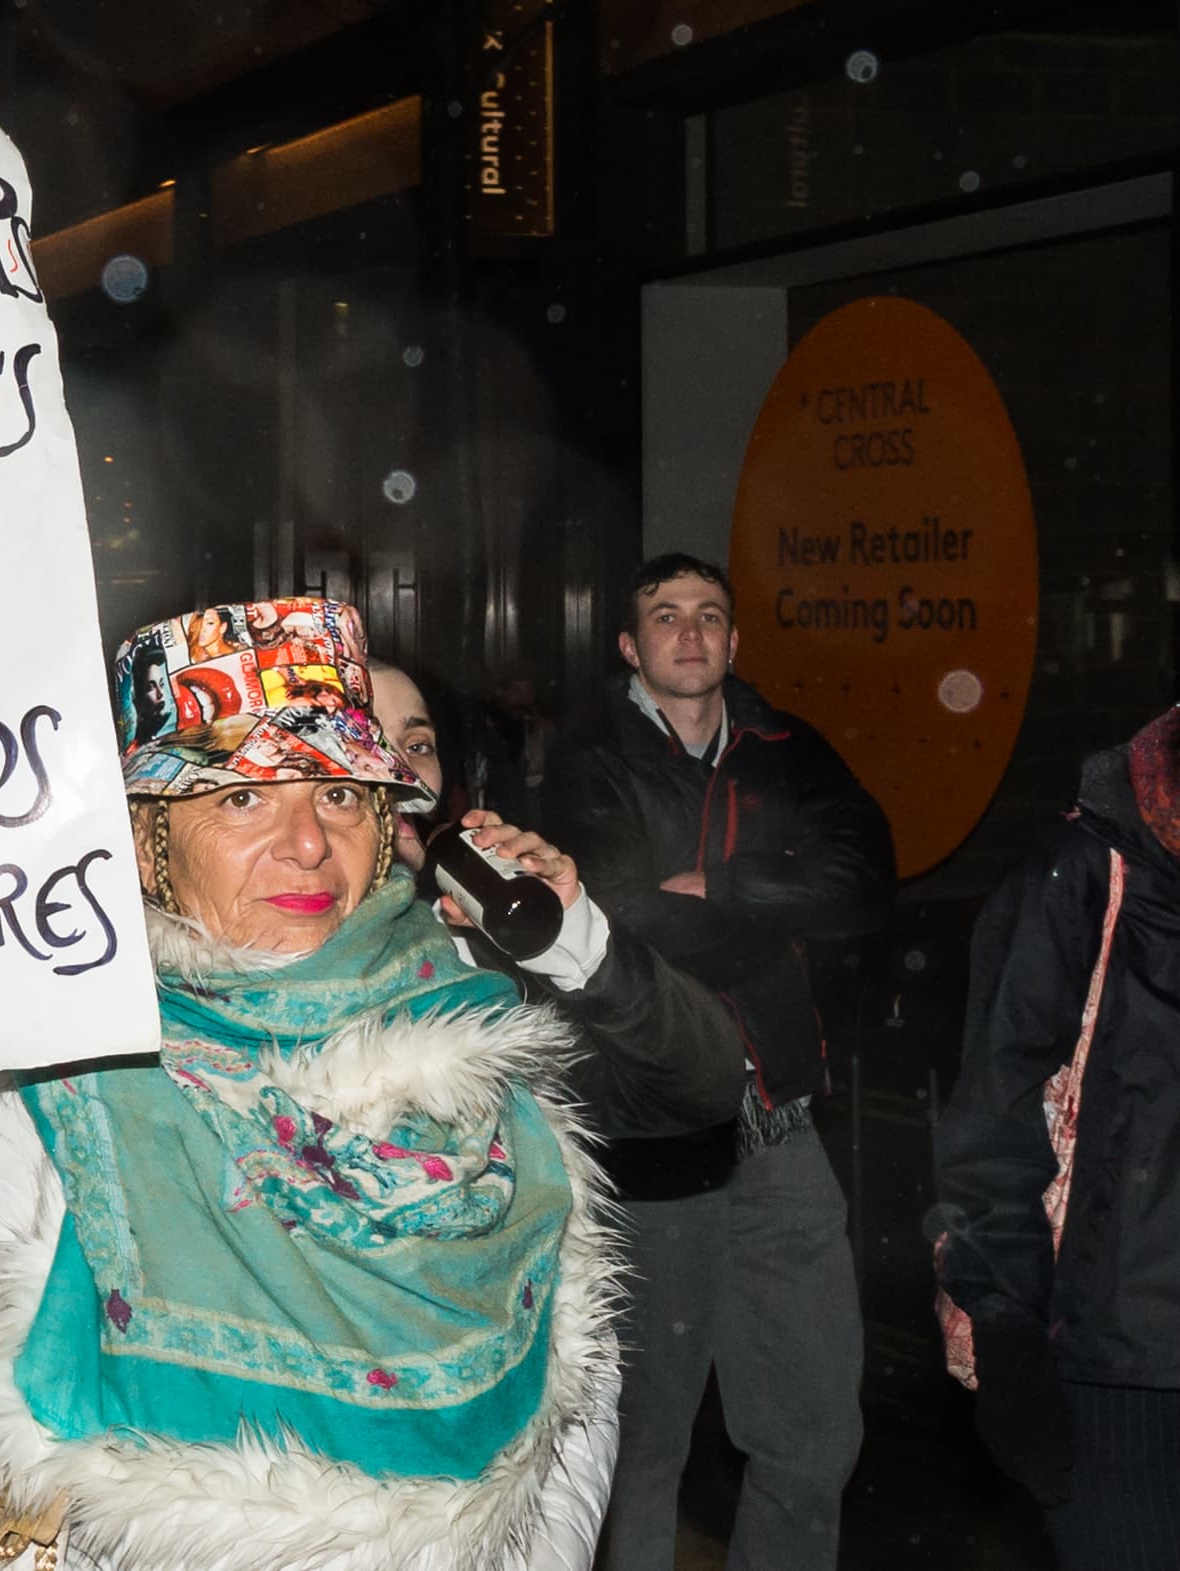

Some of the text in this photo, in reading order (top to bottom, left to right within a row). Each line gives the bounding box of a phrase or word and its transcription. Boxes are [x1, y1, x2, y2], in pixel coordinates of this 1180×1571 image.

[818, 378, 931, 425] CENTRAL
[832, 428, 915, 471] CROSS
[777, 516, 975, 566] New Retailer
[774, 584, 978, 643] Coming Soon
